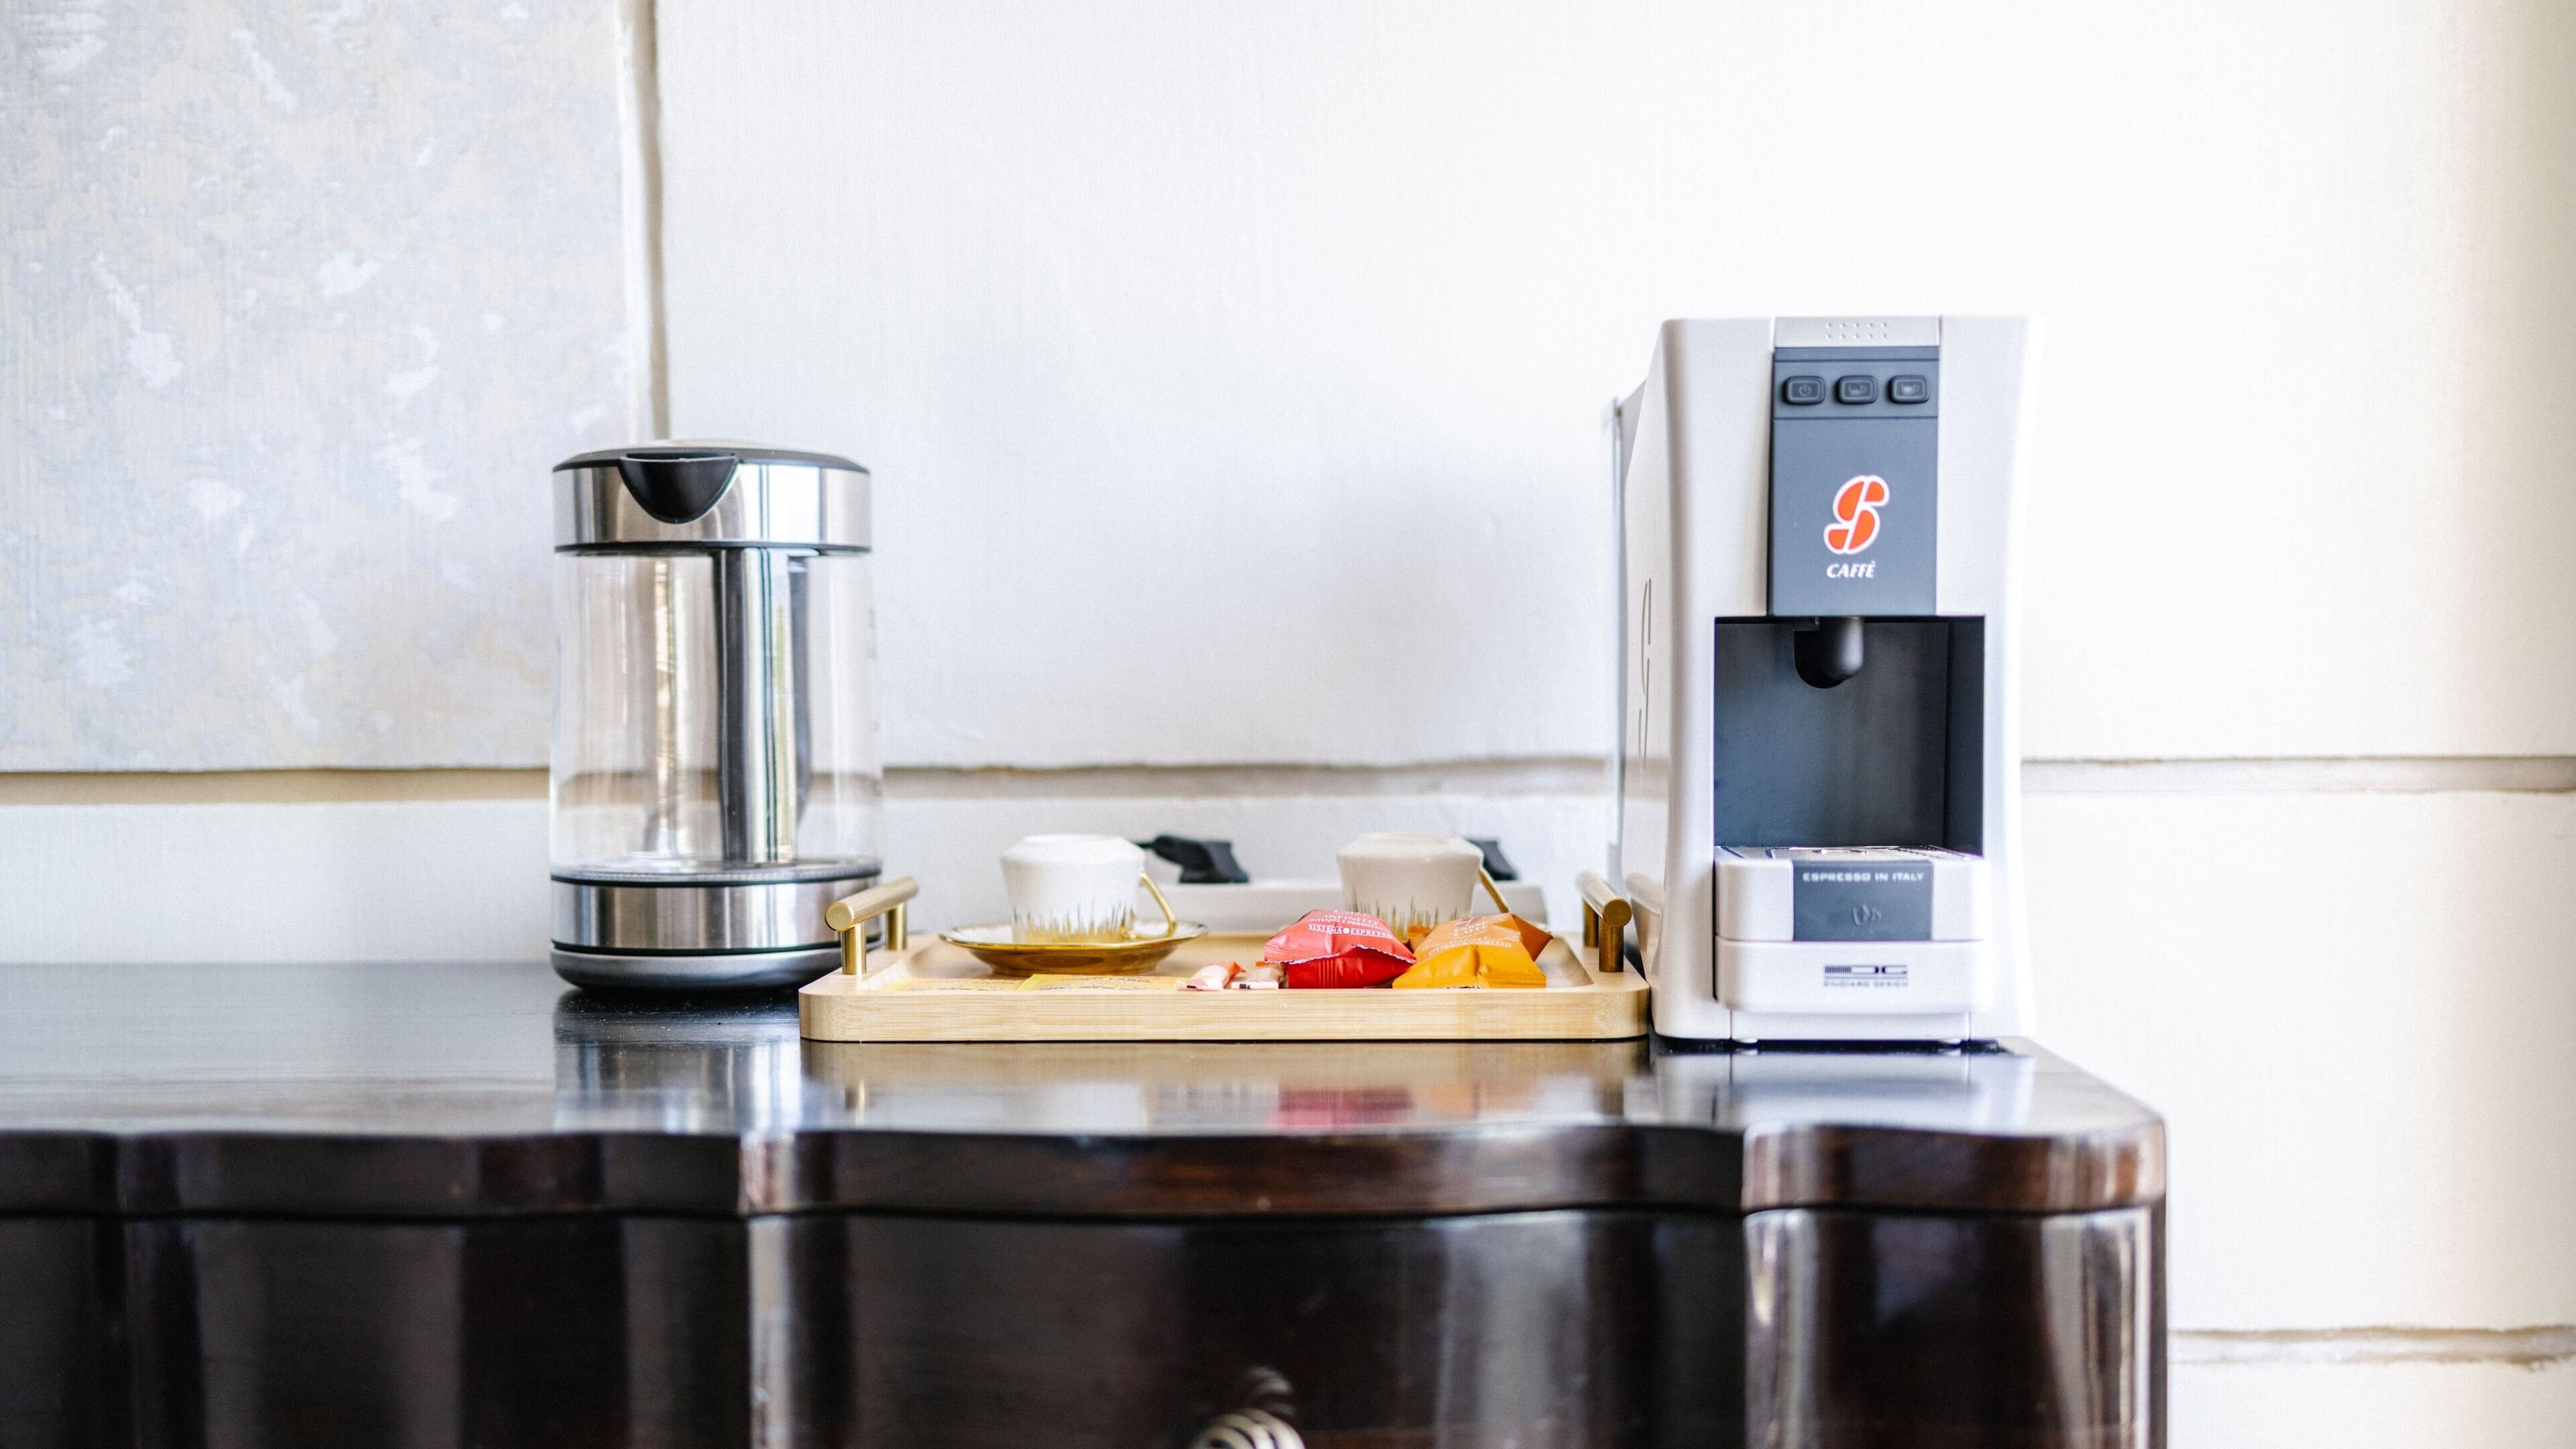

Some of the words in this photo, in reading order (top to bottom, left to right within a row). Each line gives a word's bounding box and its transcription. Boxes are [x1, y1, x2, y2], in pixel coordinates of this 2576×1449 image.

[1826, 559, 1876, 578] CAFFÈ
[1803, 871, 1871, 881] ESPRESSO
[1874, 871, 1888, 881] IN
[1892, 871, 1924, 881] ITALY
[1325, 914, 1378, 925] INFINITO
[1308, 924, 1342, 934] SISTEMA
[1350, 928, 1392, 938] ESPRESSO
